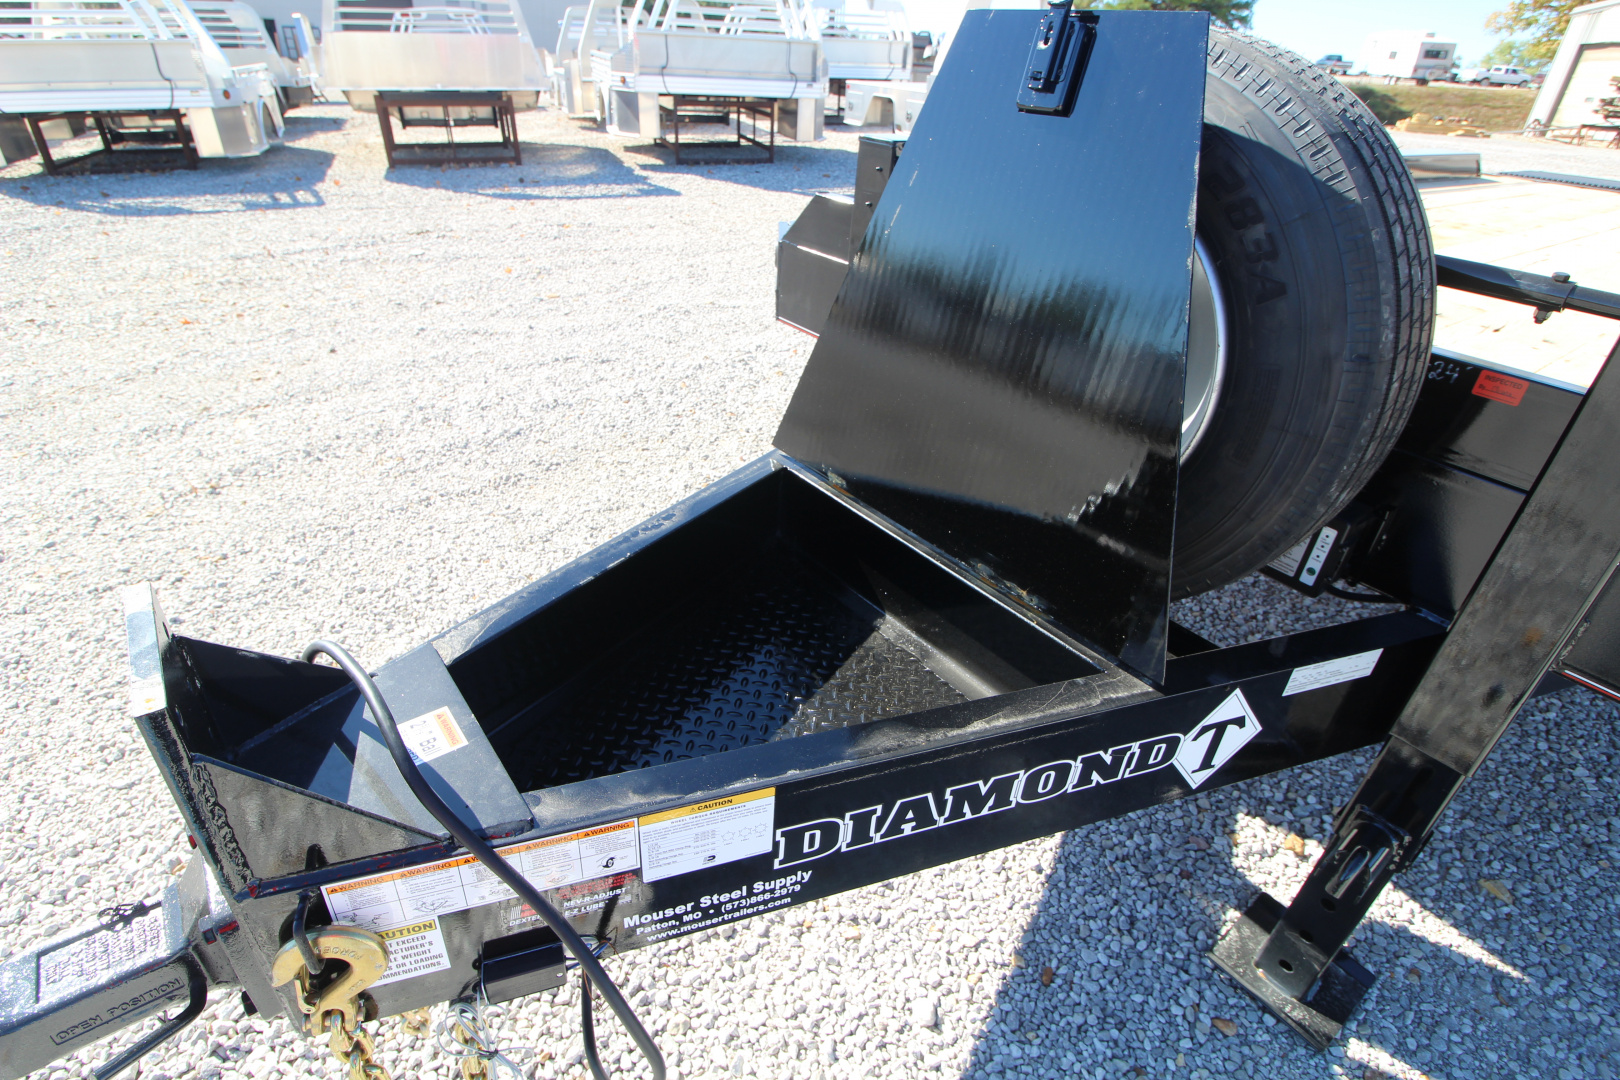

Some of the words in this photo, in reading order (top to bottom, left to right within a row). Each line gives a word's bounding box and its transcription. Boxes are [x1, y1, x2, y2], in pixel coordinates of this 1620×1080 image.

[1485, 374, 1523, 390] INSPECTED
[440, 718, 459, 745] WARNING
[774, 732, 1186, 869] DIAMOND
[1191, 715, 1246, 773] T
[697, 799, 733, 811] CAUTION
[591, 823, 630, 836] WARNING
[533, 835, 574, 848] WARNING
[407, 863, 452, 878] WARNING
[339, 877, 385, 891] WARNING
[623, 902, 694, 929] Mouser
[699, 886, 747, 909] Steel
[752, 870, 812, 894] Supply
[565, 908, 579, 917] E-Z
[581, 902, 606, 913] LUBE
[636, 917, 679, 936] Patton,
[682, 911, 702, 923] MO
[721, 884, 801, 913] (573)866-2979
[646, 896, 791, 942] www.mousertrailers.com
[389, 941, 434, 956] ACTURER'S
[396, 935, 426, 947] EXCEED
[401, 948, 431, 960] WEIGHT
[409, 953, 444, 966] LOADING
[56, 1014, 104, 1041] OPEN
[106, 978, 182, 1016] POSITION
